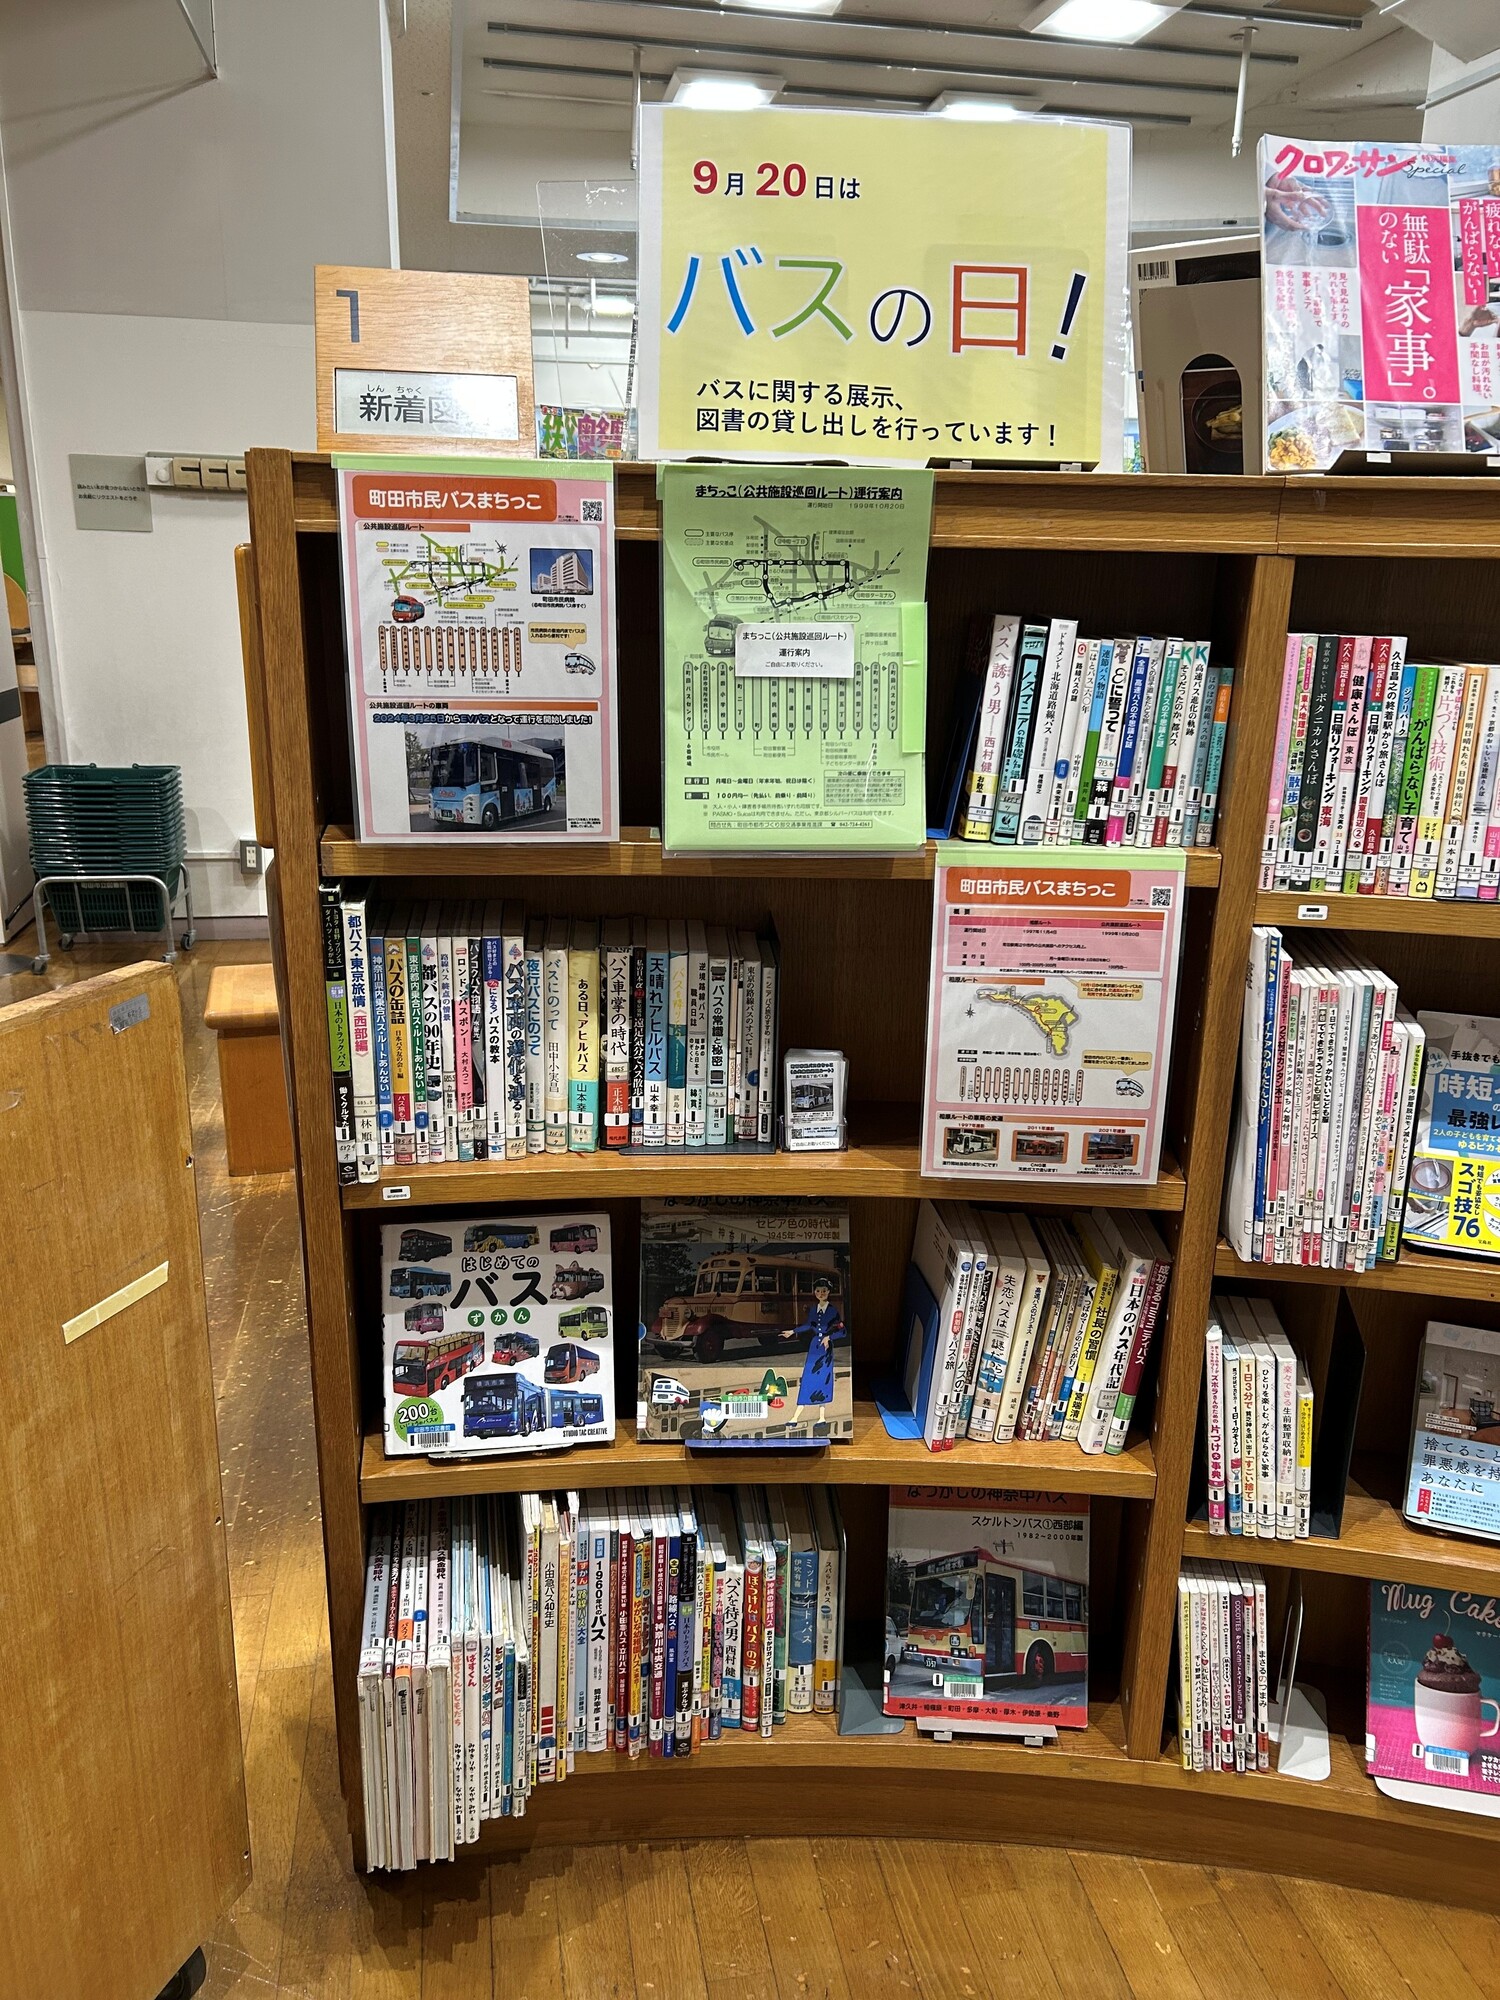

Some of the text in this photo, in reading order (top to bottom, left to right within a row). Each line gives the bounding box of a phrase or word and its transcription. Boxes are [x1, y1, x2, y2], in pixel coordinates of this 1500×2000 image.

[692, 159, 861, 200] 9月20日は
[1275, 144, 1417, 180] クロワッサン
[1402, 160, 1467, 178] Special
[1378, 211, 1400, 263] のない
[1402, 212, 1432, 265] 無駄
[1463, 201, 1483, 304] がんばらない!
[667, 246, 1088, 361] バスの日!
[1338, 272, 1350, 328] 見て見ぬふりの
[396, 386, 422, 394] ちゃく
[696, 378, 905, 411] バスに関する展示、
[696, 407, 1057, 448] 図書の貸し出しを行っています!
[369, 489, 542, 511] 町田市民バスまちっこ
[695, 485, 903, 500] まちっこ(公共施設巡回ルート)運行案内
[743, 632, 848, 642] まちっこ(公共施設巡回ルート)
[778, 648, 811, 658] 運行案内
[980, 623, 1013, 773] バスへ誘う男 西村健
[1044, 672, 1061, 734] 北海道路線バス
[1070, 662, 1082, 702] 路線バスの謎
[1125, 659, 1146, 749] 全国 高速バスの不思議と謎
[1169, 664, 1190, 747] そうだったのか、都バス
[1185, 664, 1204, 736] 高速バス進化の軌跡
[1156, 685, 1173, 748] 都バスの不思議と謎
[1307, 693, 1328, 785] ボタニカルさんぽ
[1344, 675, 1365, 765] 健康さんぽ 東京
[1375, 651, 1402, 787] 久住昌之の終着駅から旅さんぽ
[1398, 688, 1411, 736] ジブリパーク
[1429, 695, 1454, 772] 片づく技術
[1097, 759, 1114, 767] 913.6
[1319, 714, 1344, 827] 日帰りウォーキング 東海
[1360, 714, 1380, 795] 日帰りウォーキング
[1399, 718, 1430, 844] がんばらない子育て
[1287, 776, 1301, 804] 散歩
[960, 878, 1117, 897] 町田市民バスまちっこ
[347, 915, 366, 1008] 都バス・東京旅情
[1268, 938, 1277, 982] IKEA
[388, 958, 406, 1025] バスの缶詰
[421, 964, 441, 1071] 都バスの90年史
[526, 958, 541, 1057] 夜行バスにのって
[546, 958, 562, 1030] バスにのって
[609, 957, 627, 1056] バス車掌の時代
[647, 957, 665, 1075] 天晴れアヒルバス
[334, 1001, 347, 1067] 日本のトラック・バス
[489, 1016, 500, 1064] バスの教本
[577, 979, 589, 1073] ある日、アヒルバス
[711, 985, 725, 1066] バスの常識と秘密
[1258, 1020, 1274, 1125] イケアのかんたんDIY
[756, 1218, 840, 1229] セピア色の時代編
[767, 1232, 840, 1240] 1945年～1970年製
[449, 1271, 549, 1310] バス
[461, 1256, 540, 1272] はじめての
[470, 1309, 529, 1325] ずかん
[996, 1275, 1016, 1328] 失恋バスは
[1135, 1265, 1171, 1365] 成功するコミュニティバス
[1085, 1307, 1108, 1361] 社長の習慣
[1105, 1284, 1144, 1389] 日本のバス年代記
[1243, 1363, 1254, 1411] 1日3分で
[562, 1427, 608, 1438] STUDIO TAC CREATIVE
[1231, 1406, 1240, 1454] 1日1分そうじ
[1261, 1369, 1270, 1478] ひとりを楽しむ、がんばらない家事
[1282, 1407, 1292, 1457] 生前整理収納
[1421, 1471, 1484, 1494] あなたに
[971, 1515, 1084, 1531] スケルトンバス①西部編
[1017, 1532, 1084, 1542] 1982～2000年製
[544, 1562, 555, 1628] 小田急バス40年史
[590, 1561, 606, 1642] 1960年代のバス
[801, 1559, 812, 1644] ミッドナイト・バス
[1381, 1583, 1436, 1619] Mug
[653, 1622, 664, 1678] 神奈川中央交通
[725, 1577, 741, 1677] バスを待つ男 西村健
[453, 1654, 463, 1727] ばすくんのともだち
[466, 1654, 478, 1687] ばすくん
[1258, 1650, 1267, 1708] まさるのつまみ
